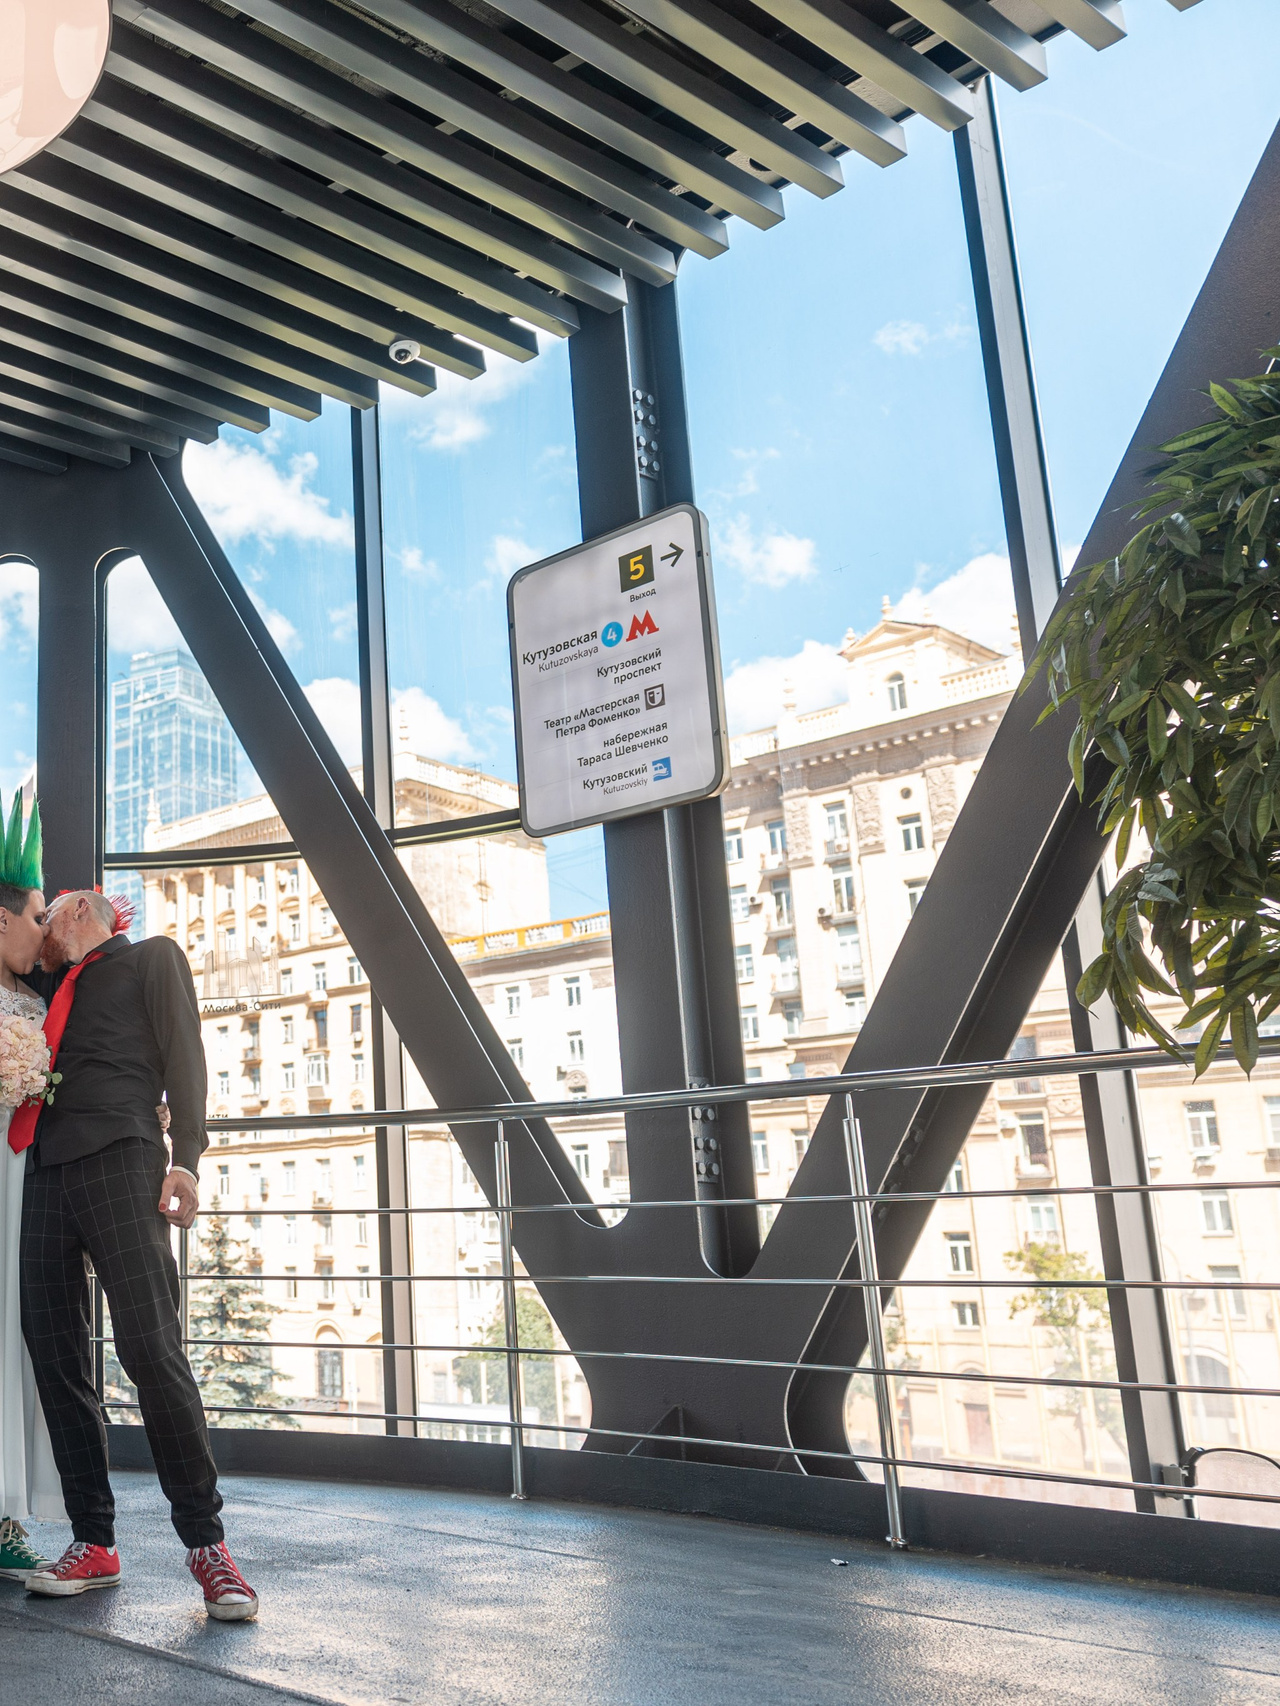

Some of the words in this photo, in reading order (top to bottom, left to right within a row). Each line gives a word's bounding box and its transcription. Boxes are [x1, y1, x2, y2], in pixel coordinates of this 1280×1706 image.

[629, 554, 645, 581] 5
[629, 587, 657, 603] Выход
[522, 630, 598, 665] Кутузовская
[538, 645, 599, 673] Kutuzovskaya
[596, 648, 662, 678] Кутузовский
[613, 661, 662, 685] проспект
[544, 714, 572, 730] Театр
[573, 692, 640, 722] «Мастерская
[555, 723, 586, 739] Петра
[588, 706, 641, 729] Фоменко»
[603, 721, 668, 748] набережная
[577, 751, 613, 767] Тараса
[614, 734, 669, 758] Шевченко
[582, 764, 648, 790] Кутузовский
[603, 777, 648, 796] Kutuzovskiy
[202, 1000, 282, 1014] Москва-Сити
